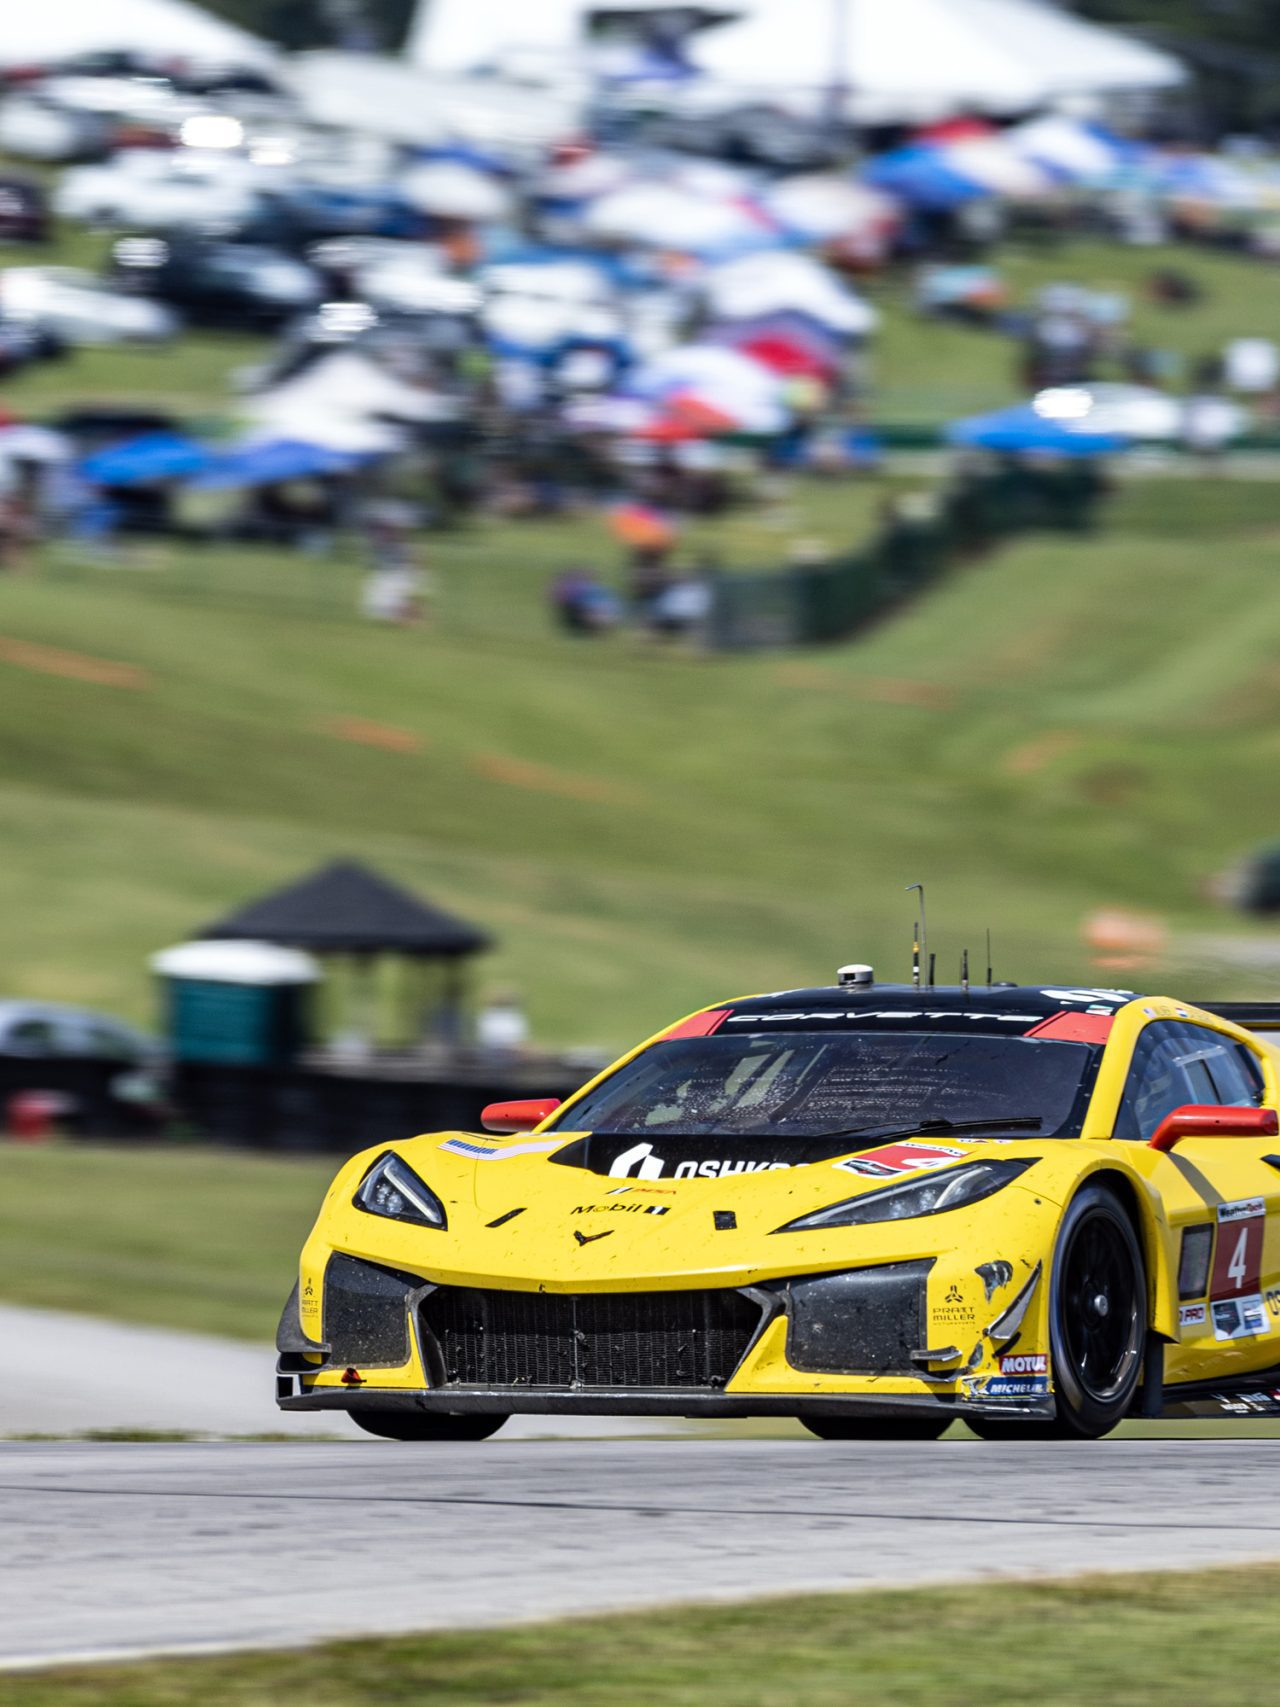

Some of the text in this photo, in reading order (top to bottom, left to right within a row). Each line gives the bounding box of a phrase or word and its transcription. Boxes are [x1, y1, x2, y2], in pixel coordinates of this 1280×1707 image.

[726, 1012, 1044, 1022] CORVETTE
[570, 1203, 643, 1215] Mobil
[1227, 1227, 1249, 1289] 4
[932, 1313, 976, 1321] MILLER
[1001, 1356, 1047, 1373] MOTUL
[990, 1382, 1044, 1394] MICHELIN
